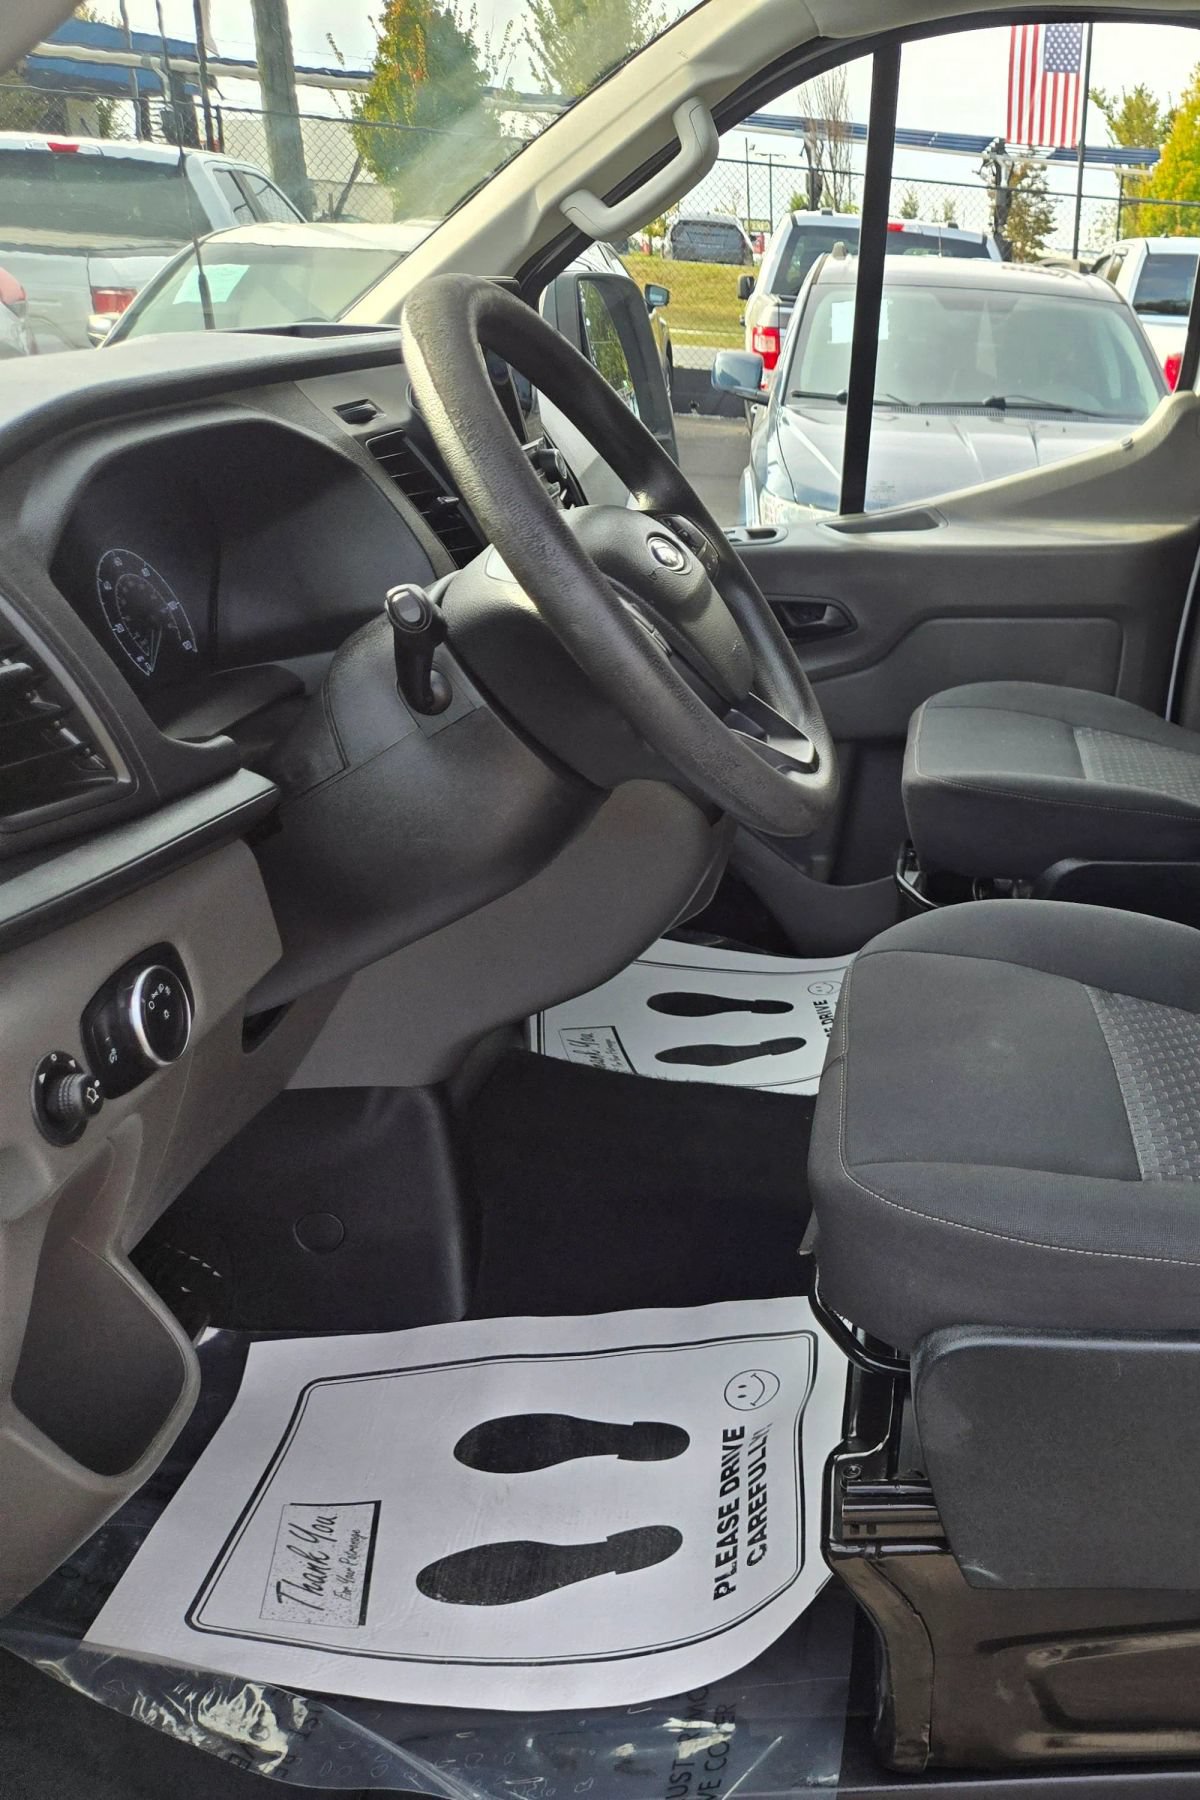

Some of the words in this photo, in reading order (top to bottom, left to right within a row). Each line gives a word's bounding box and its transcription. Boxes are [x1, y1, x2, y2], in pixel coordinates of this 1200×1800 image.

[812, 999, 834, 1026] DRIVE
[719, 1425, 746, 1498] DRIVE
[746, 1422, 773, 1567] CAREFULLY!
[287, 1515, 338, 1543] You
[713, 1497, 740, 1601] PLEASE
[276, 1545, 331, 1611] Thank
[704, 1703, 737, 1771] COER
[665, 1760, 694, 1800] UST
